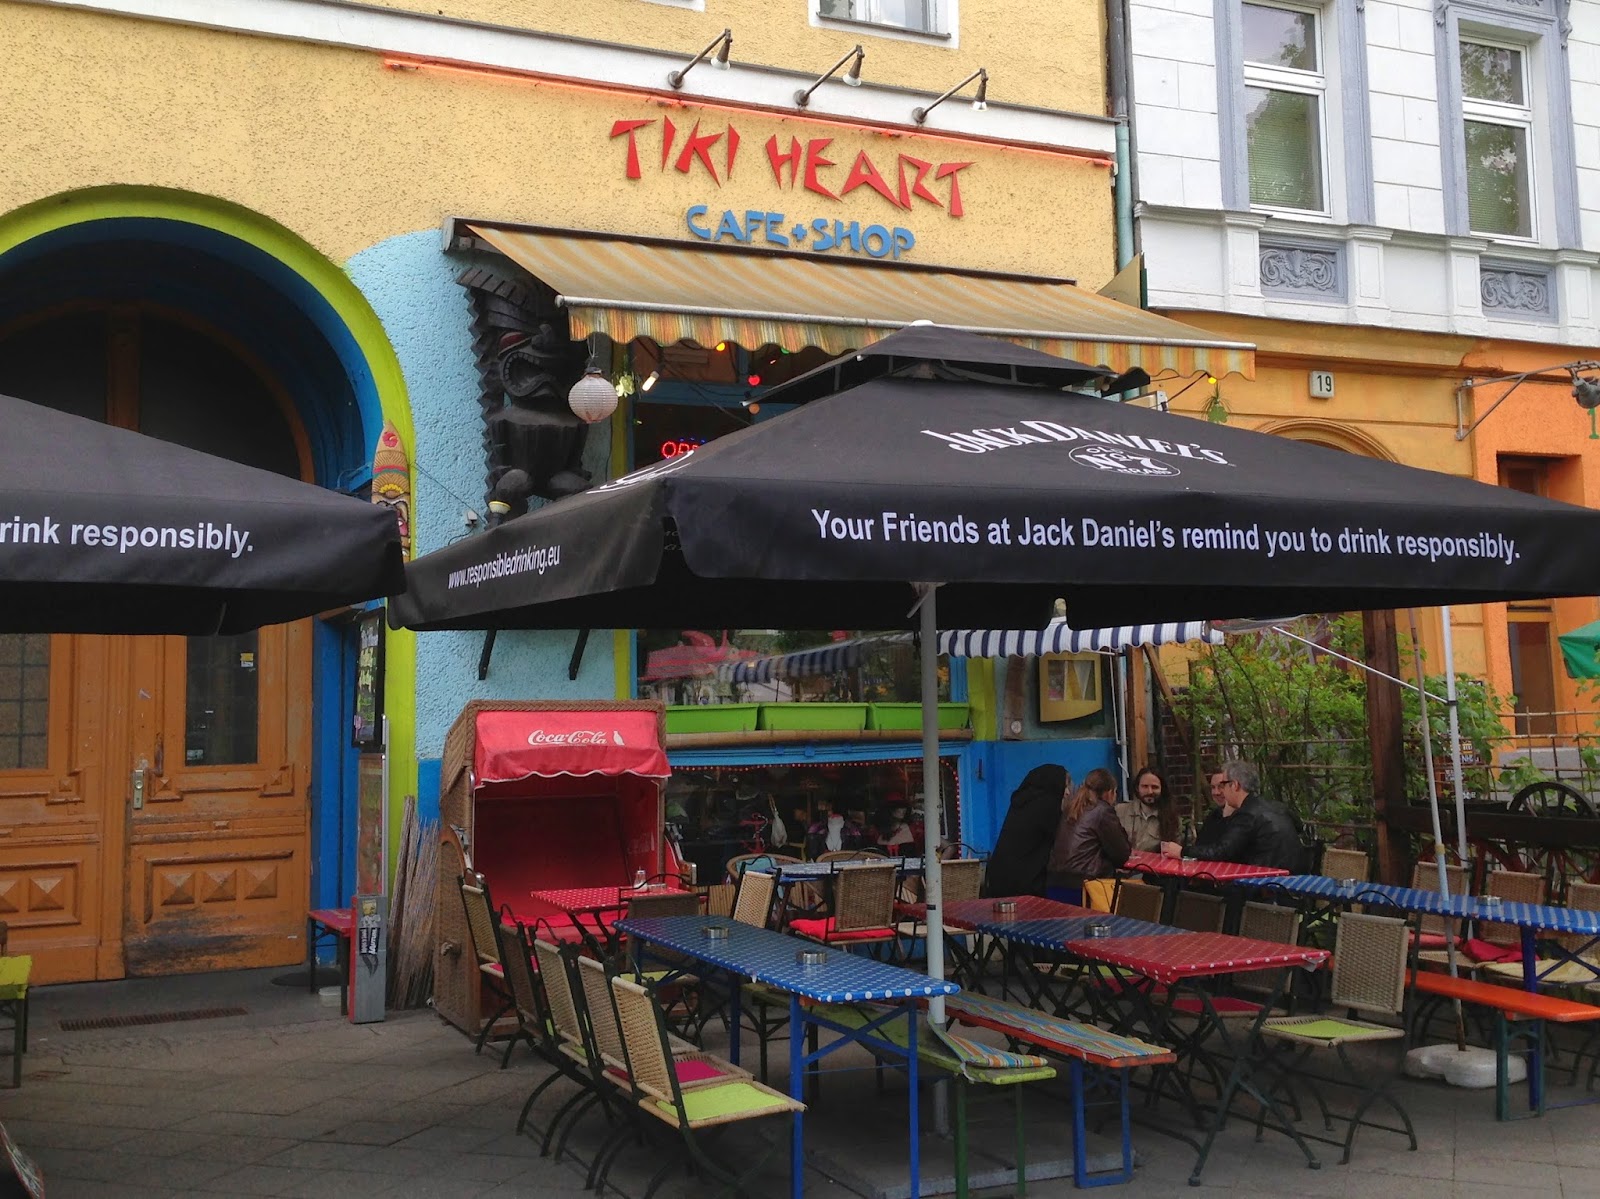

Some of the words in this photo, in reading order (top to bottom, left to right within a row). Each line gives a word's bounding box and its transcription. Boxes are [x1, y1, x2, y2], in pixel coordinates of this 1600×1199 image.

[610, 114, 741, 189] TIKI
[765, 133, 977, 217] HEART
[1317, 374, 1332, 392] 19
[70, 522, 254, 559] responsibly.
[811, 508, 875, 541] Your
[882, 511, 980, 544] Friends
[987, 517, 1012, 545] at
[1017, 516, 1075, 546] Jack
[1082, 518, 1176, 549] Daniel's
[1182, 522, 1260, 550] remind
[1264, 530, 1306, 558] you
[1310, 527, 1332, 553] to
[1338, 527, 1392, 554] drink
[1396, 532, 1521, 565] responsibly.
[447, 544, 561, 590] www.responsibledrinking.eu
[527, 729, 608, 746] Coca-Cola
